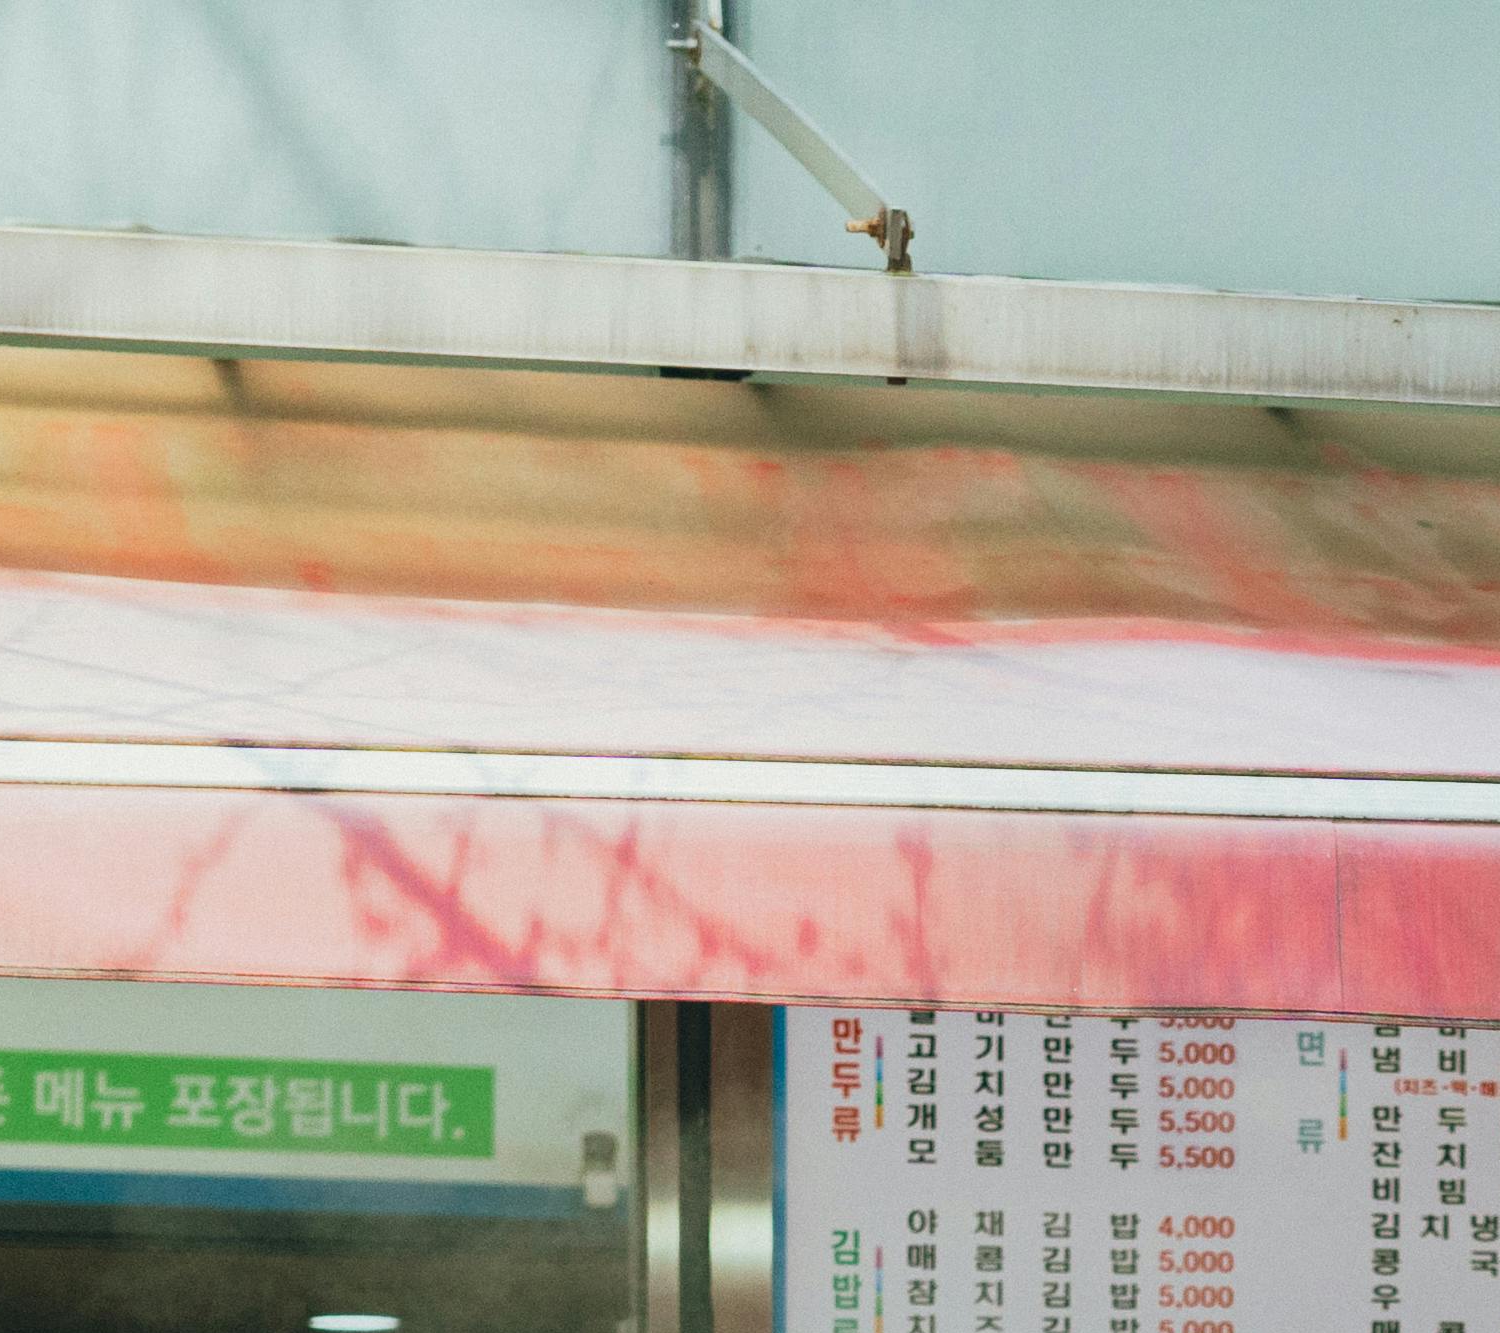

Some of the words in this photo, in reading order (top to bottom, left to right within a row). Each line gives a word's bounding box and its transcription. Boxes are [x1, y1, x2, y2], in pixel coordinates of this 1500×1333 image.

[908, 1034, 1139, 1065] 고기만두
[1159, 1041, 1236, 1065] 5,000
[832, 1018, 862, 1142] 만두류
[908, 1068, 1138, 1100] 김치만두
[1158, 1075, 1235, 1100] 5,000
[1297, 1031, 1325, 1154] 면류
[33, 1067, 146, 1130] 메뉴
[166, 1073, 467, 1143] 포장됩니다.
[908, 1103, 1139, 1135] 개성만두
[1159, 1109, 1235, 1134] 5,500
[1159, 1145, 1235, 1169] 5,500
[907, 1209, 1140, 1240] 야채김밥
[1158, 1215, 1235, 1239] 4,000
[1159, 1250, 1234, 1273] 5,000
[908, 1279, 1140, 1310] 참치김밥
[1159, 1285, 1234, 1309] 5,000
